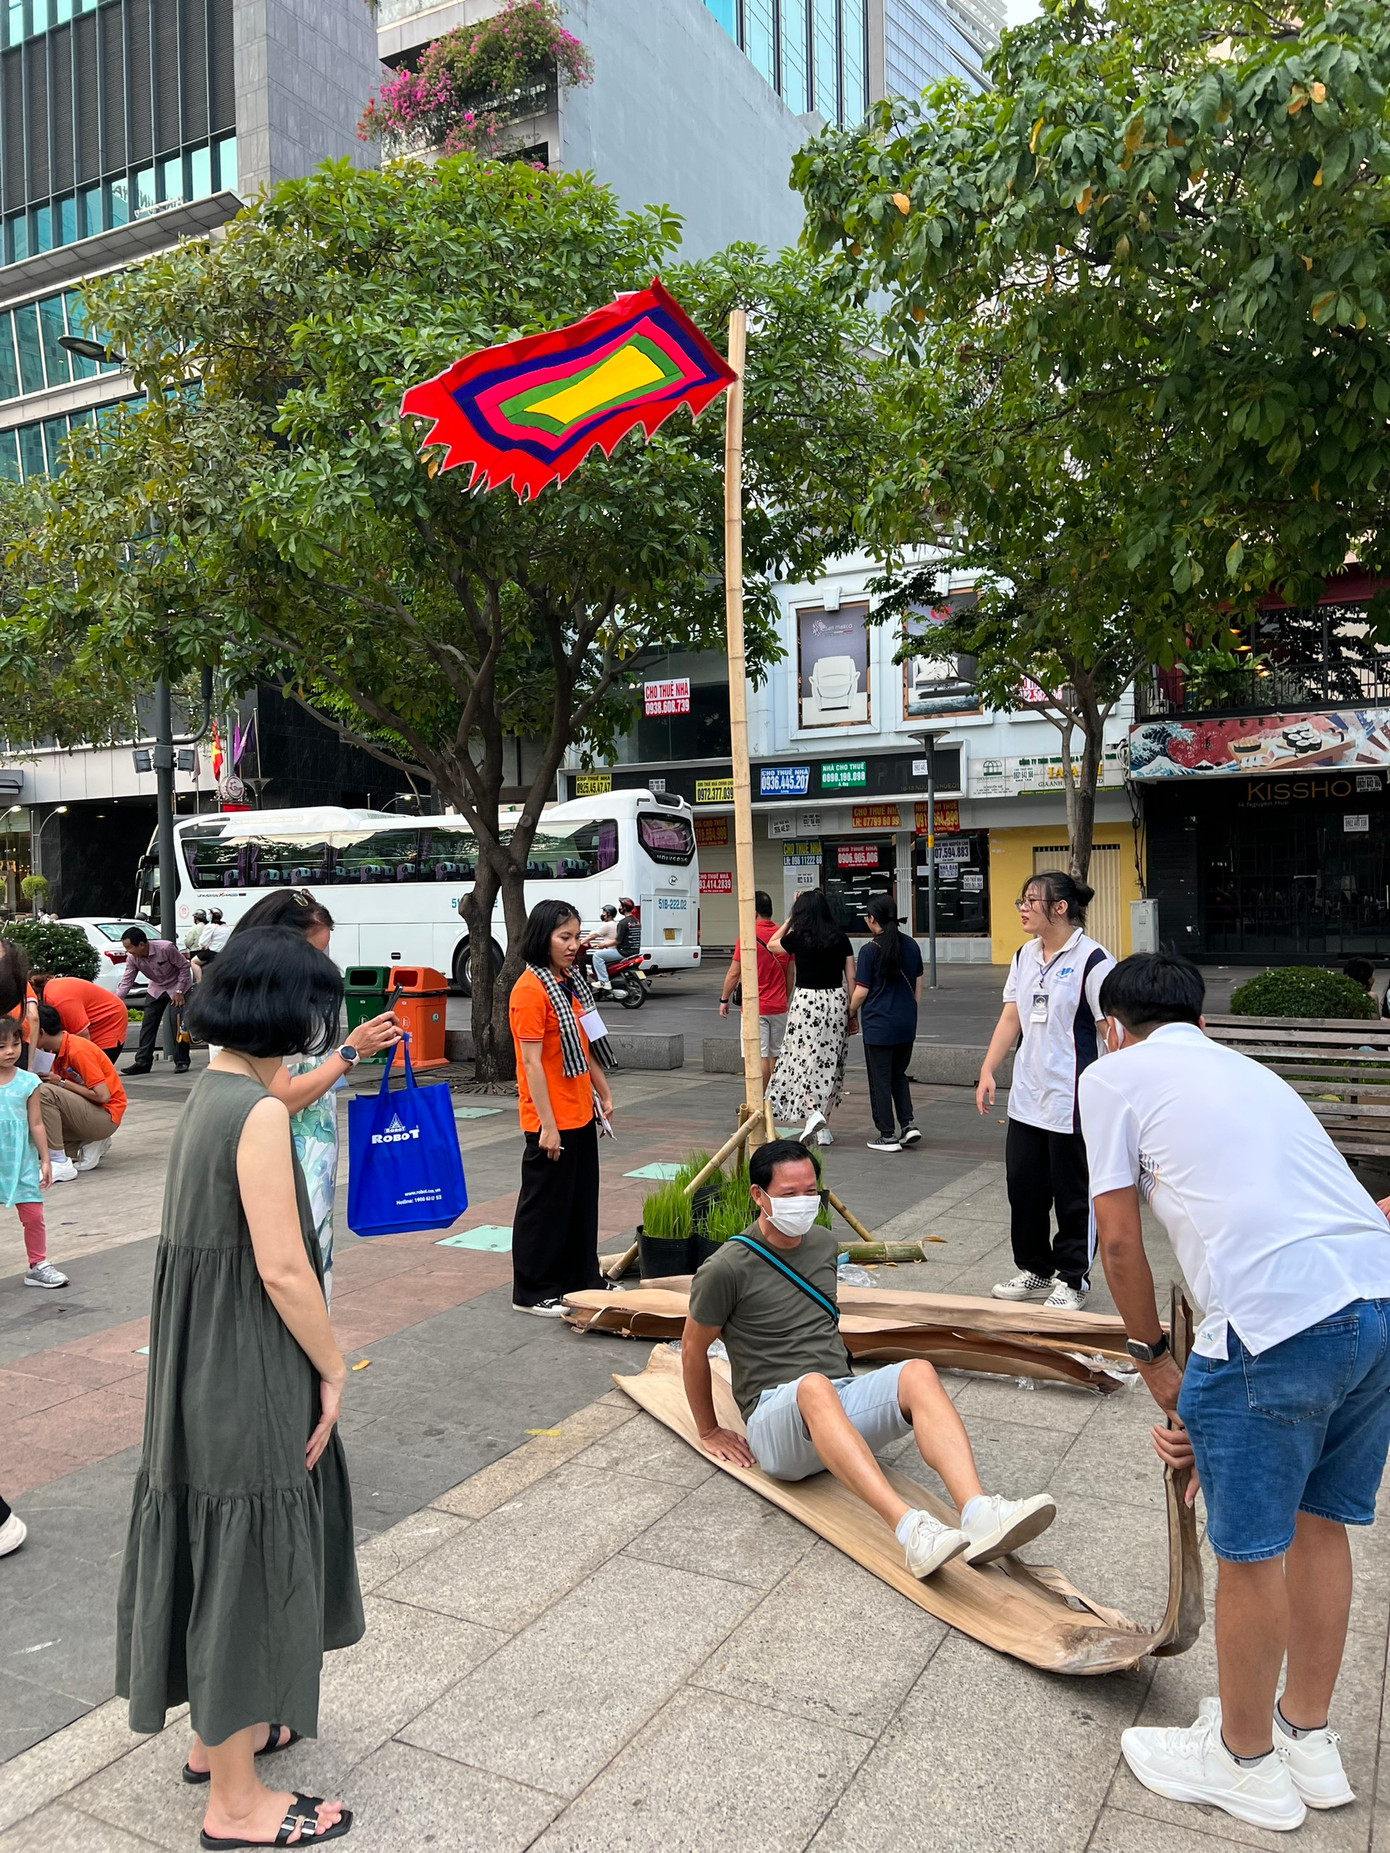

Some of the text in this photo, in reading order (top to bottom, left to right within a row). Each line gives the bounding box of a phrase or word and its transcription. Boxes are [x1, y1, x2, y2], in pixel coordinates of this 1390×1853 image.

[646, 685, 657, 699] CHO
[676, 680, 688, 697] NHÀ
[822, 763, 835, 771] NHÀ
[1247, 779, 1352, 801] KISSHO
